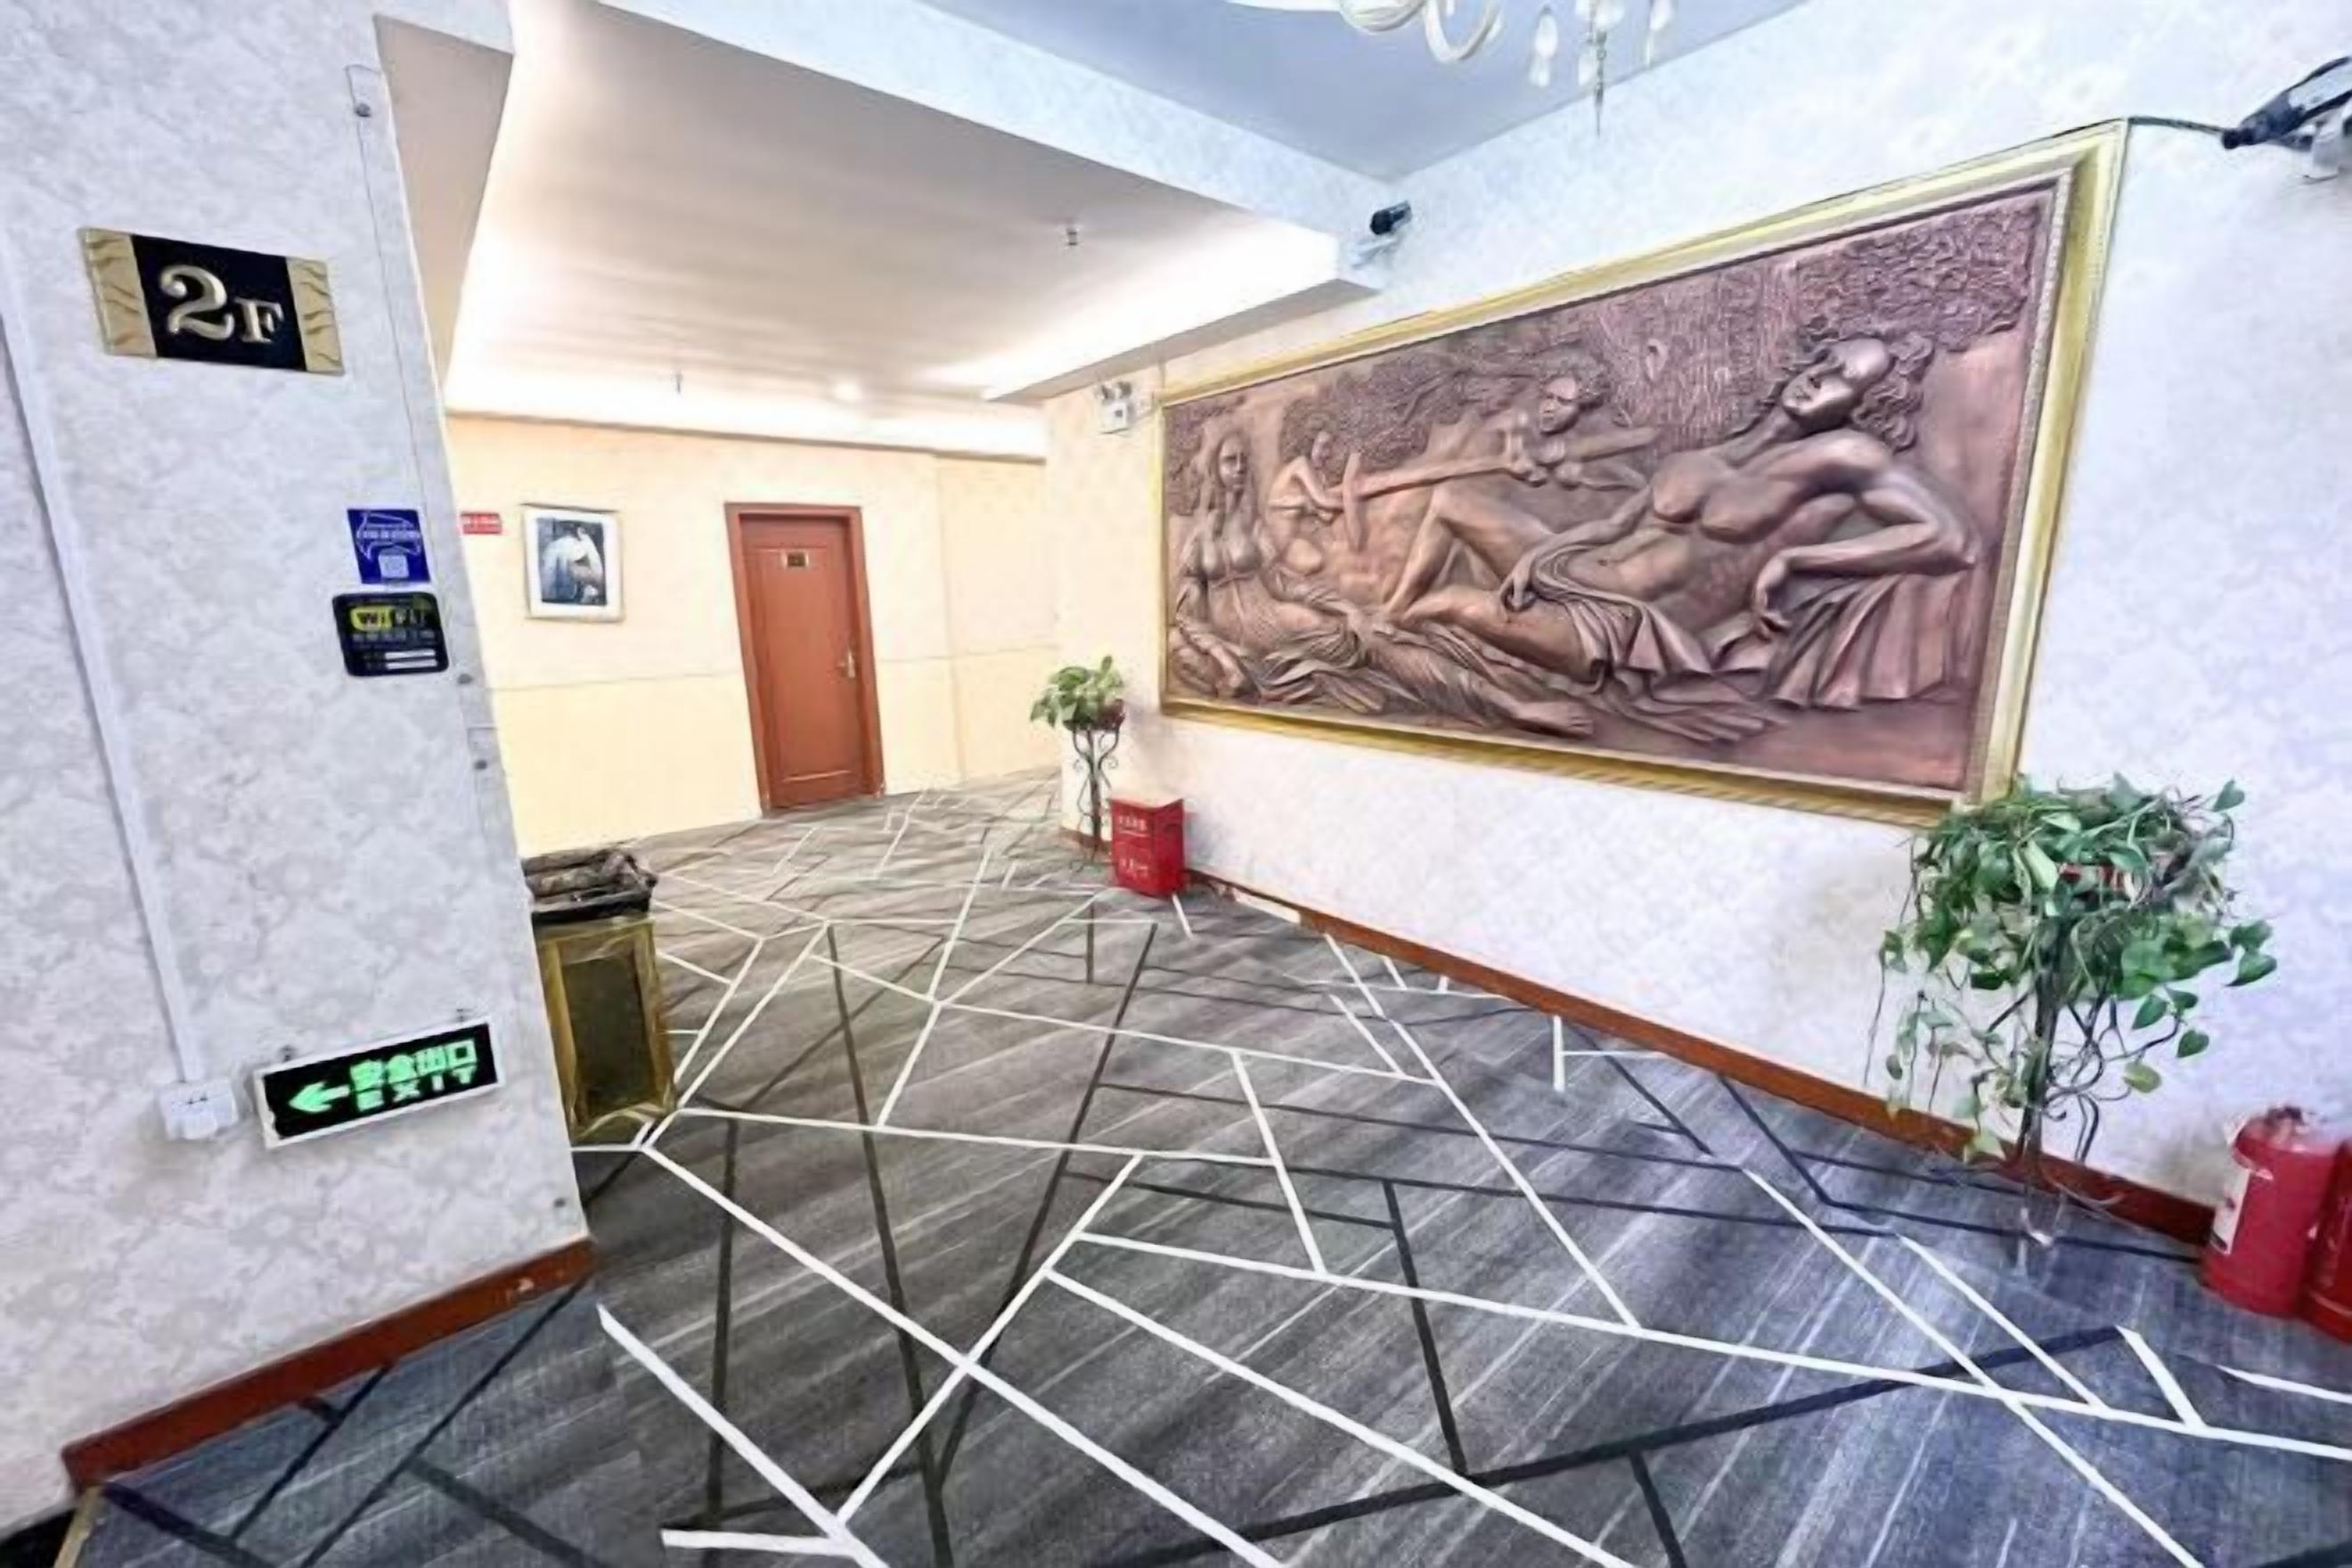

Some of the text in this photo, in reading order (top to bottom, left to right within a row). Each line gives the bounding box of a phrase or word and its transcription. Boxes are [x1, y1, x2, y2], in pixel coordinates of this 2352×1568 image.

[160, 265, 284, 343] 2F
[350, 1040, 478, 1093] 安全出口
[356, 1064, 478, 1111] EXIT
